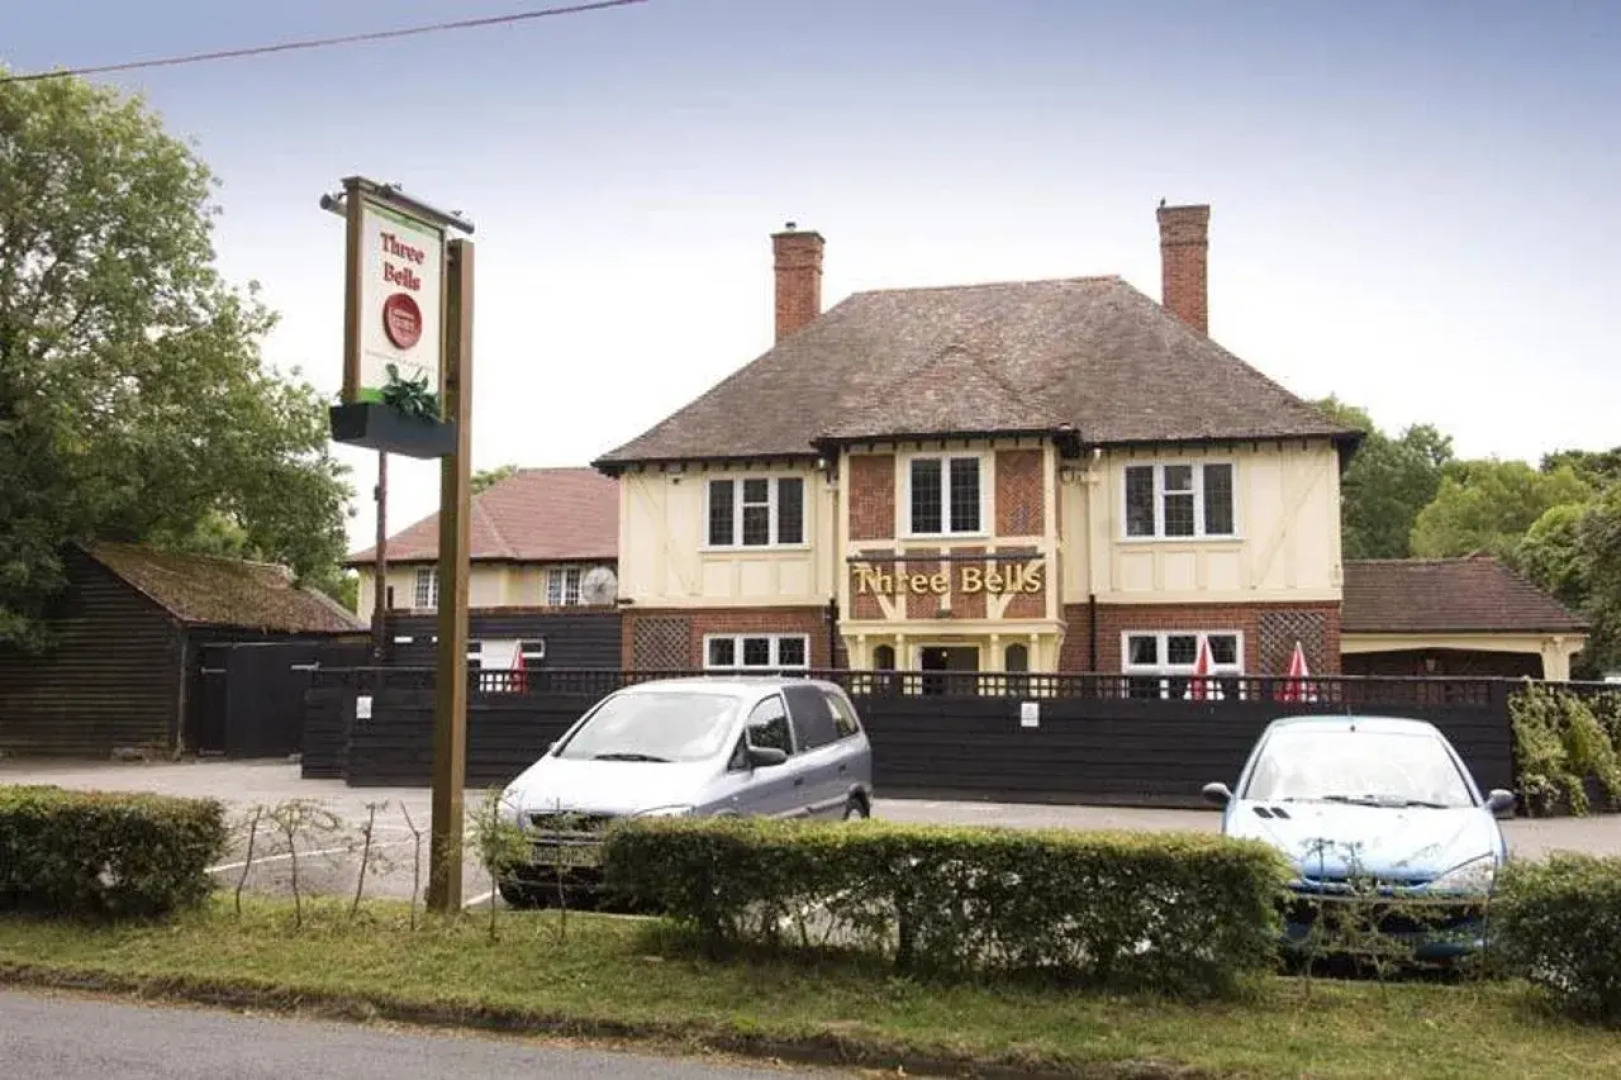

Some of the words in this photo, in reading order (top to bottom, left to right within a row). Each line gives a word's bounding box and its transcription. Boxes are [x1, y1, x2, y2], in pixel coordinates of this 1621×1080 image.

[380, 231, 424, 265] Three
[383, 261, 420, 291] Bells
[853, 565, 949, 595] Three
[960, 563, 1042, 594] Bells
